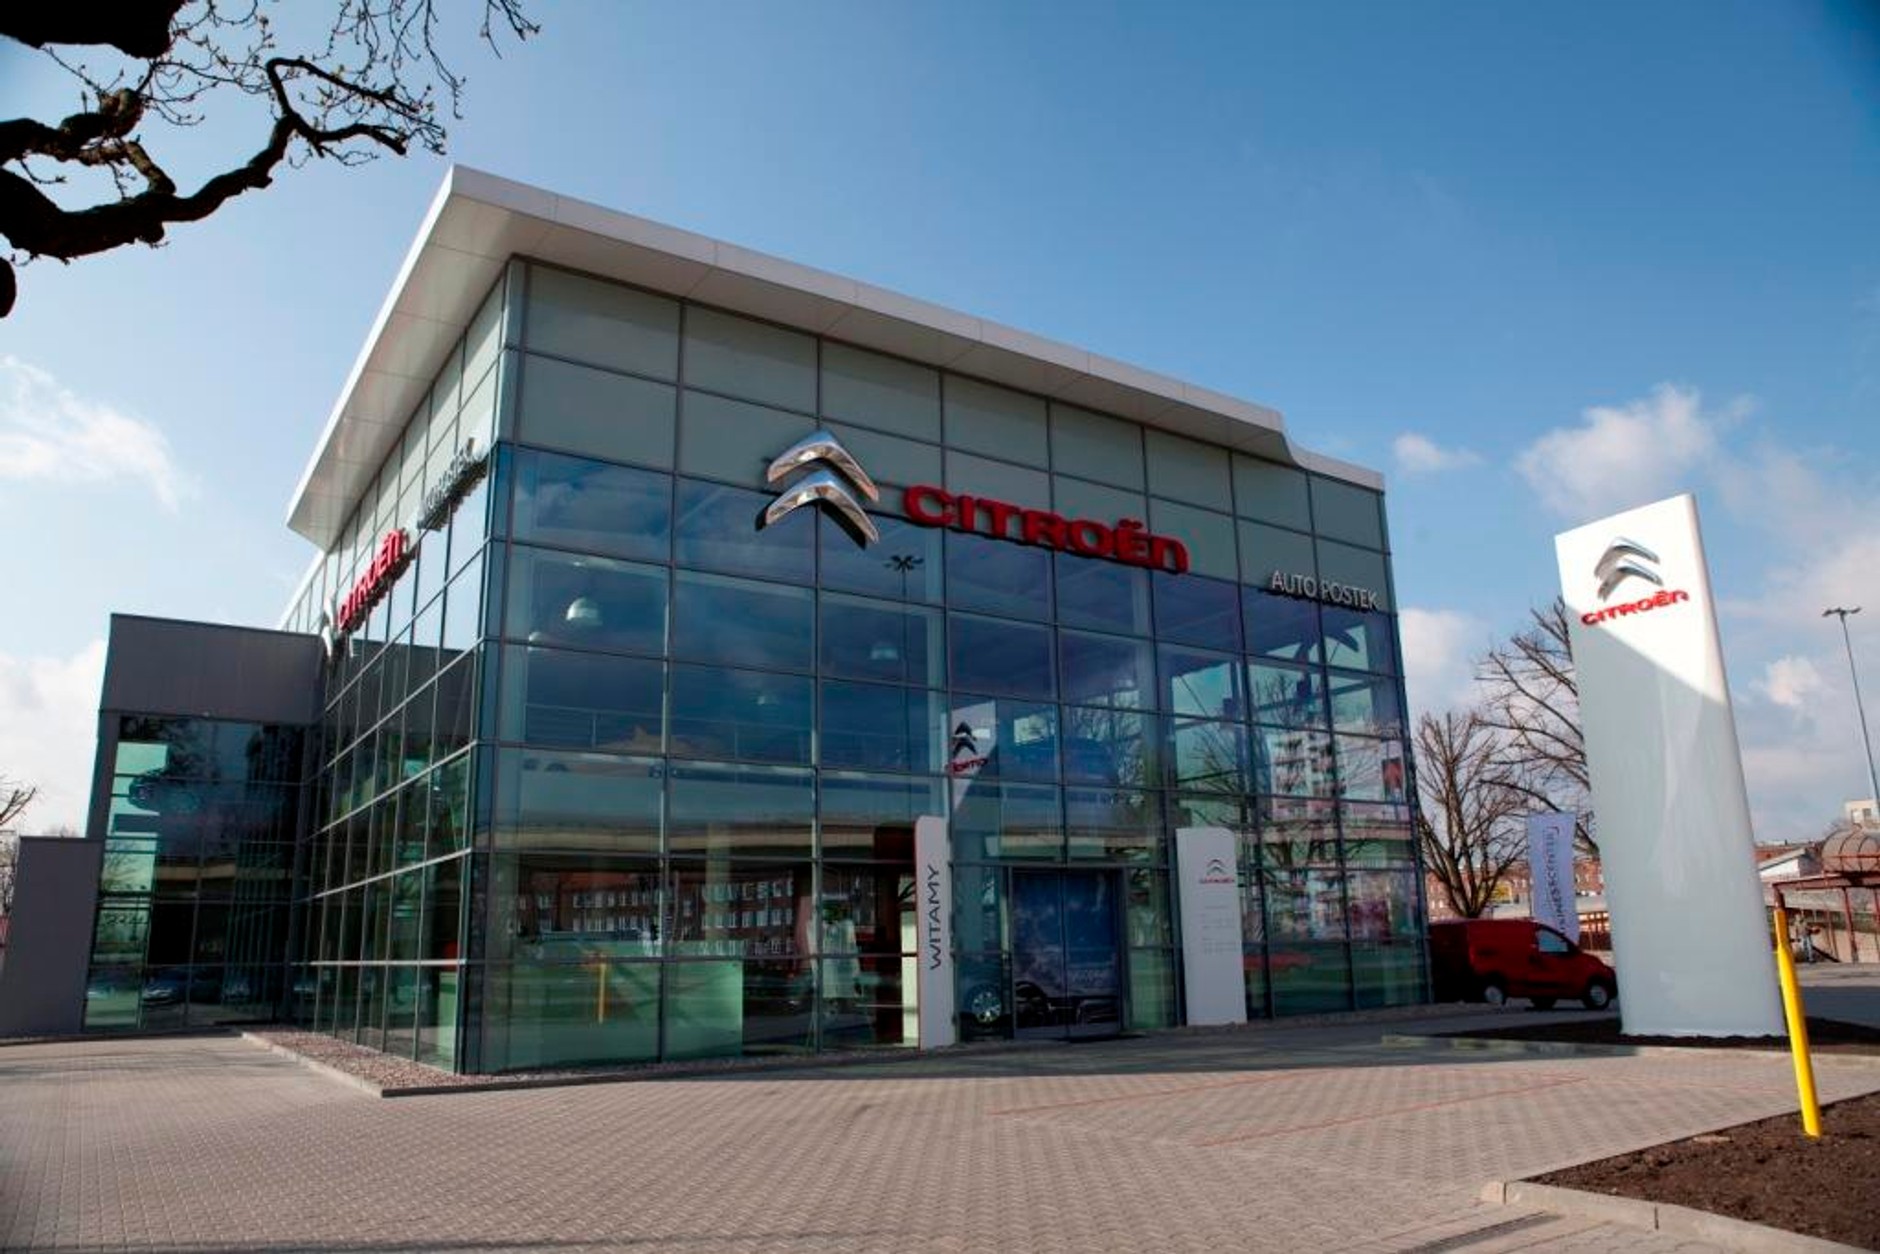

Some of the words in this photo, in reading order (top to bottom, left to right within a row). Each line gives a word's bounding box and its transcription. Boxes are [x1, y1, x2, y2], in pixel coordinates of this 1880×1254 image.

[904, 484, 1190, 574] CITROËN
[1271, 569, 1317, 598] AUTO
[927, 864, 941, 970] WITAMY
